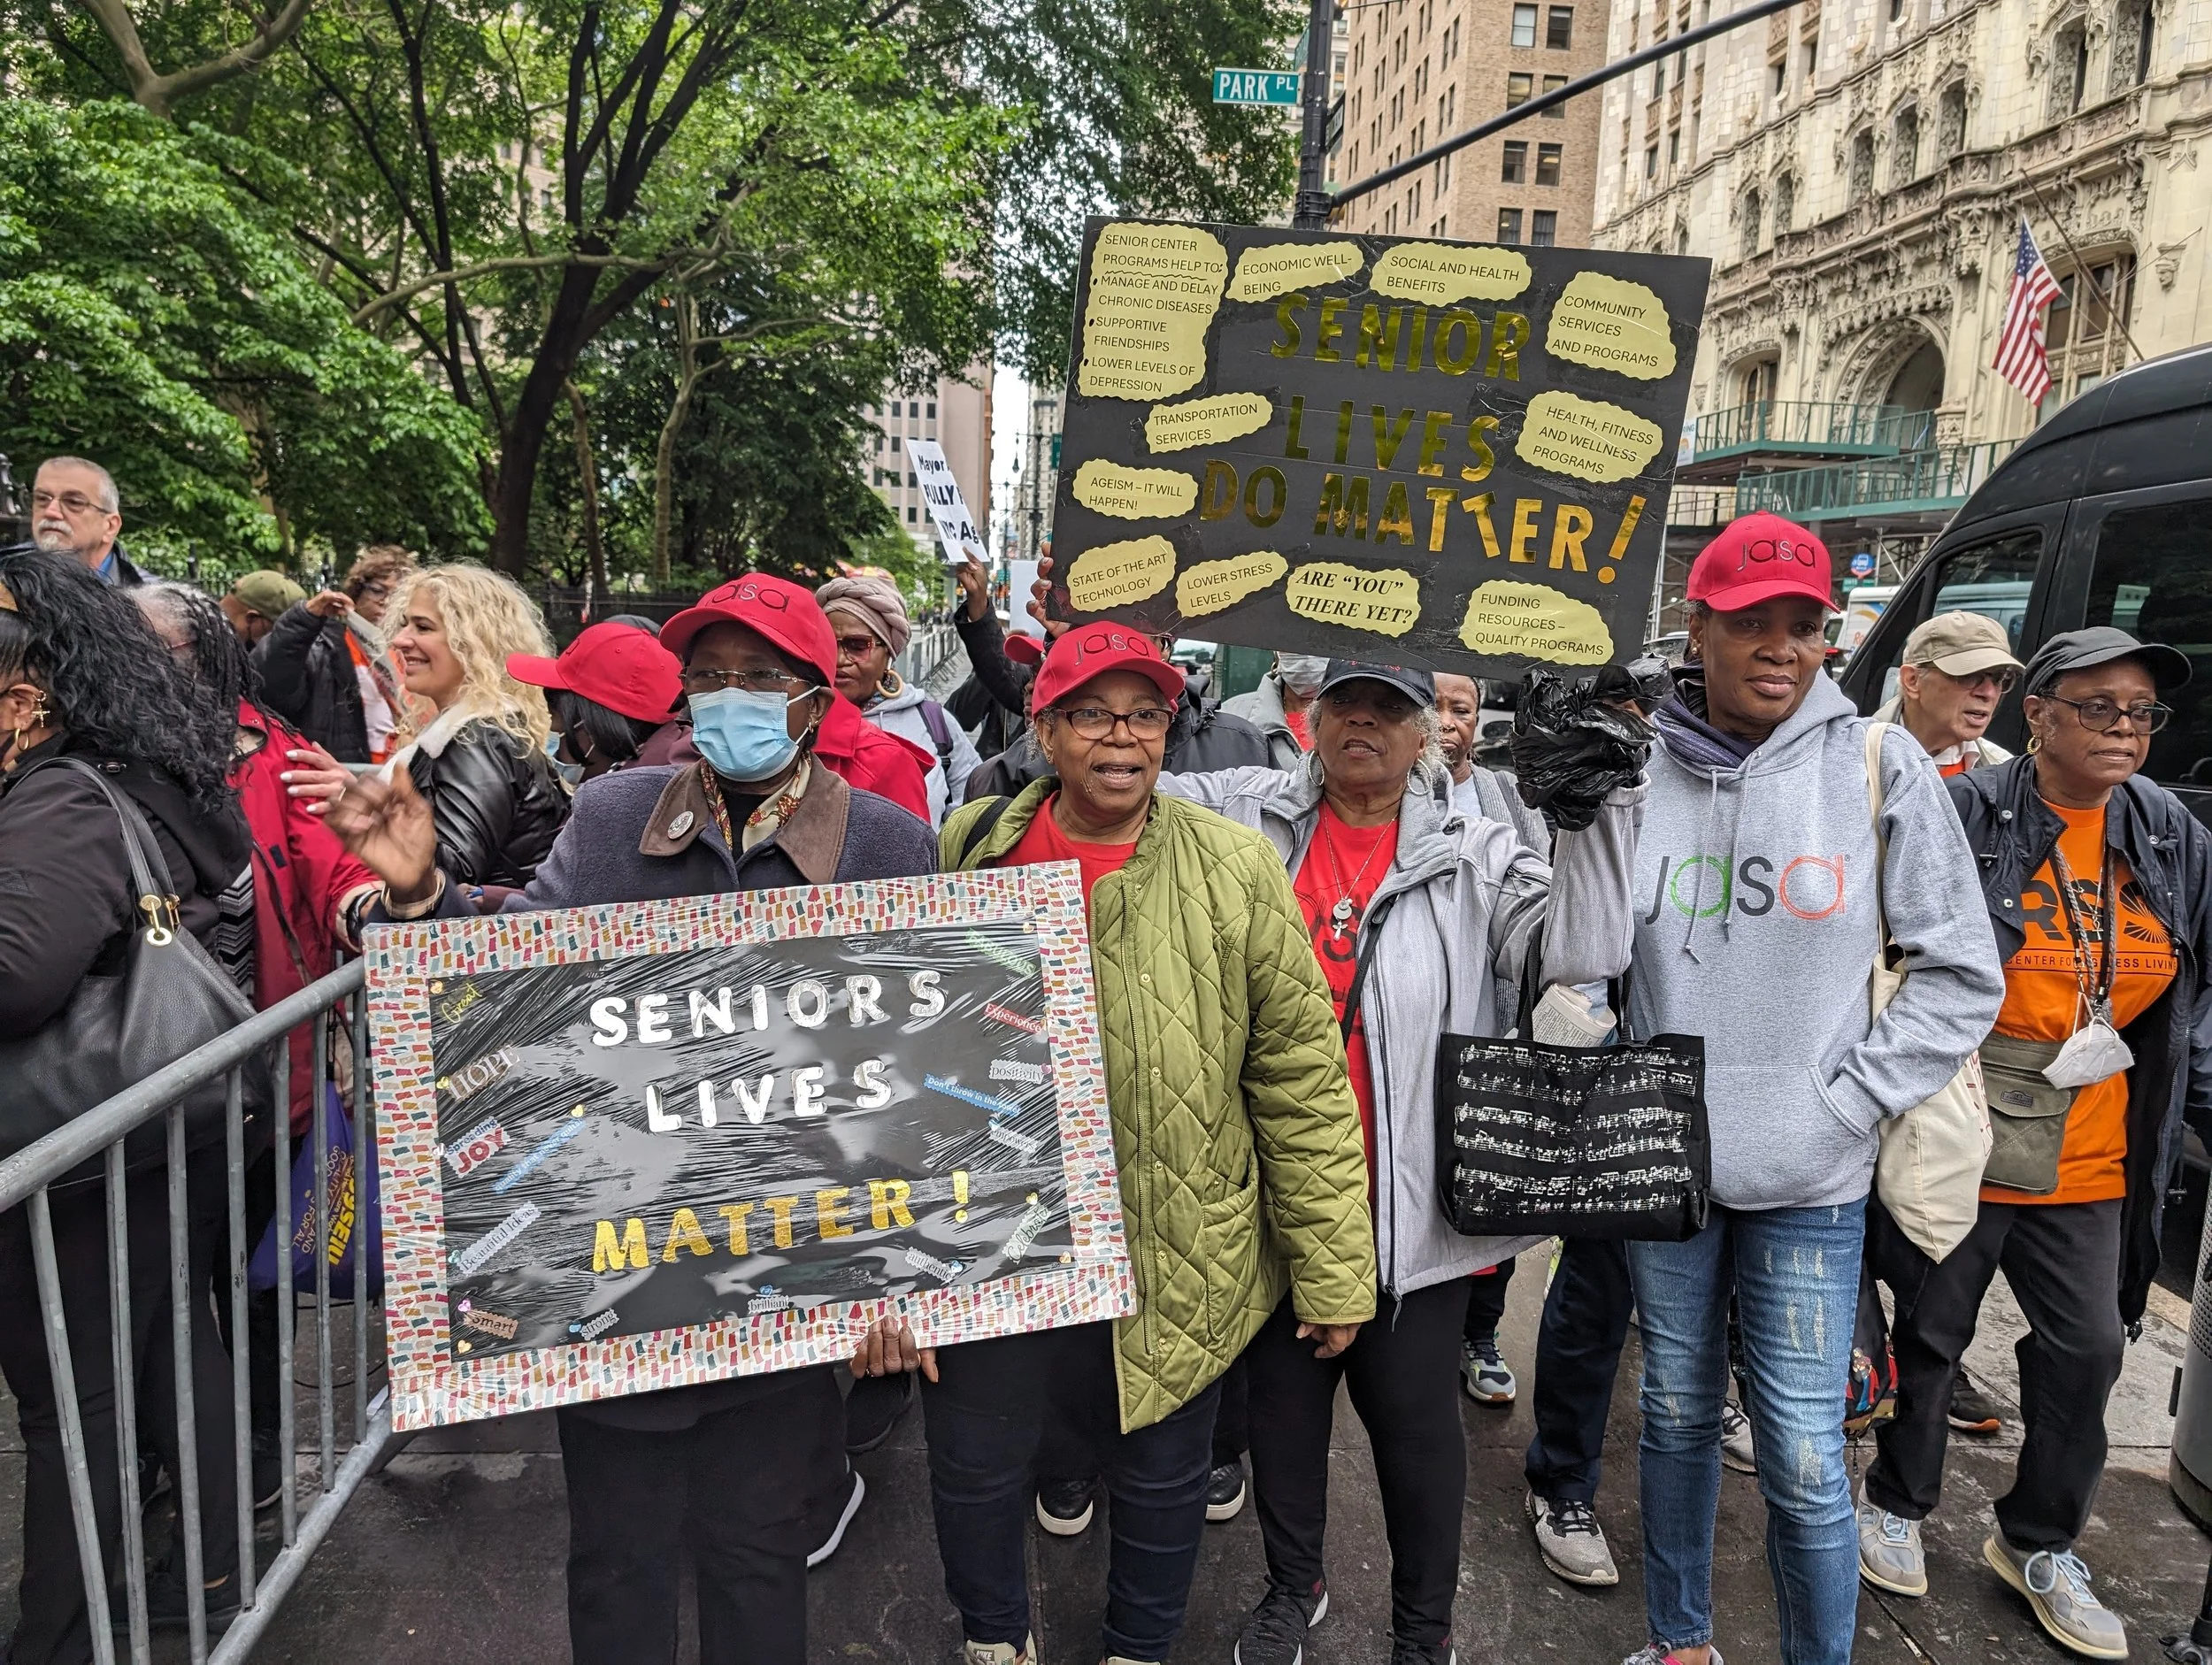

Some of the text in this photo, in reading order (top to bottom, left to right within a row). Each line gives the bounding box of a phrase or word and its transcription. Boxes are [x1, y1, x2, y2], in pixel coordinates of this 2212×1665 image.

[1219, 73, 1294, 100] PARK PL
[1104, 234, 1198, 251] SENIOR CENTER
[1103, 254, 1169, 269] PROGRAMS
[1170, 259, 1202, 272] HELP
[1242, 253, 1352, 276] ECONOMIC WELL-
[1390, 256, 1519, 281] SOCIAL AND HEALTH
[1101, 276, 1219, 295] MANAGE AND DELAY
[1244, 281, 1281, 295] BEING
[1386, 276, 1446, 293] BENEFITS
[1098, 295, 1212, 315] CHRONIC DISEASES
[1563, 295, 1647, 319] COMMUNITY
[1095, 317, 1167, 333] SUPPORTIVE
[1270, 293, 1531, 381] SENIOR
[1559, 316, 1621, 337] SERVICES
[1094, 335, 1170, 352] FRIENDSHIPS
[1552, 339, 1658, 367] AND PROGRAMS
[1091, 357, 1195, 376] LOWER LEVELS OF
[1089, 376, 1163, 393] DEPRESSION
[1154, 403, 1258, 426] TRANSPORTATION
[1547, 406, 1654, 445] HEALTH, FITNESS
[1156, 429, 1211, 444] SERVICES
[1285, 395, 1500, 481] LIVES
[1539, 426, 1637, 462] AND WELLNESS
[918, 455, 944, 474] Mayor
[1532, 445, 1604, 474] PROGRAMS
[1090, 477, 1133, 491] AGEISM
[1143, 482, 1154, 494] IT
[1156, 485, 1182, 497] WILL
[1200, 459, 1288, 528] DO
[1089, 495, 1138, 510] HAPPEN!
[1737, 539, 1816, 572] jasa
[1072, 554, 1167, 587] STATE OF THE ART
[1187, 563, 1273, 590] LOWER STRESS
[1076, 577, 1151, 605] TECHNOLOGY
[1295, 572, 1404, 595] ARE “YOU”
[705, 584, 790, 613] asa
[1190, 591, 1231, 608] LEVELS
[1294, 595, 1413, 624] THERE YET?
[1480, 594, 1540, 609] FUNDING
[1478, 613, 1555, 630] RESOURCES
[1074, 633, 1149, 664] jasa
[1476, 633, 1604, 656] QUALITY PROGRAMS
[1646, 854, 1846, 925] jasa
[442, 983, 483, 1023] Great
[589, 971, 947, 1047] SENIORS
[985, 1003, 1042, 1032] Experience
[449, 1045, 520, 1100] HOPE
[991, 1066, 1044, 1081] positivity
[646, 1060, 892, 1132] LIVES
[929, 1078, 950, 1090] Don't
[951, 1085, 973, 1098] throw
[984, 1096, 996, 1106] the
[447, 1119, 497, 1155] Spreading
[458, 1128, 504, 1173] JOY
[461, 1208, 534, 1270] Beautiful Ideas
[909, 1253, 951, 1279] authentic
[750, 1300, 788, 1311] brilliant
[582, 1312, 617, 1335] strong
